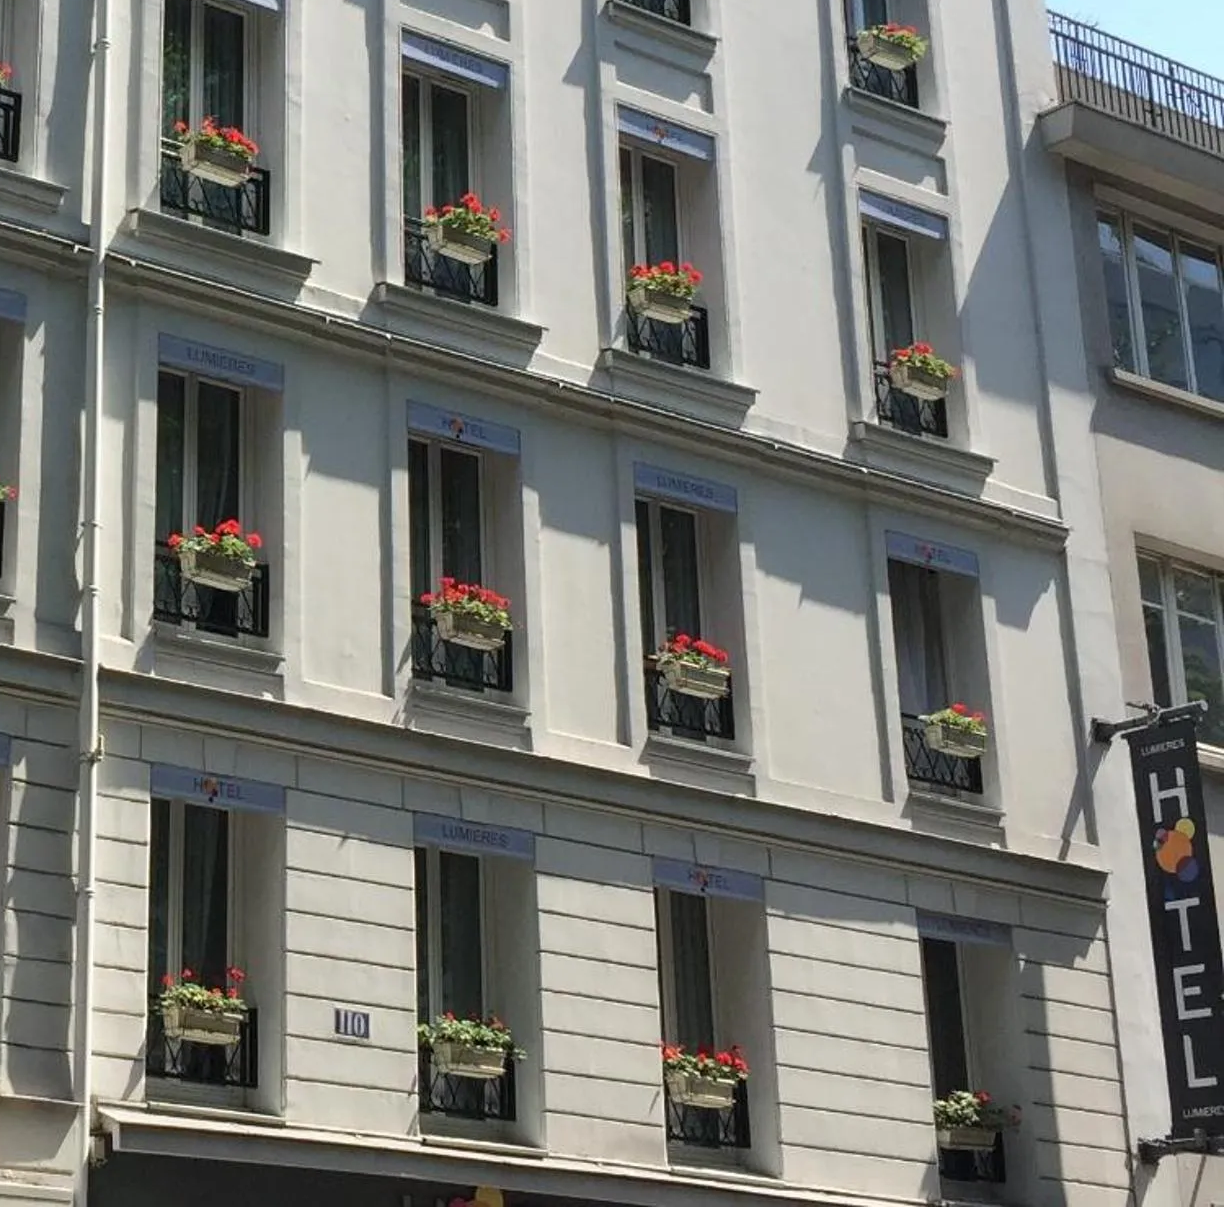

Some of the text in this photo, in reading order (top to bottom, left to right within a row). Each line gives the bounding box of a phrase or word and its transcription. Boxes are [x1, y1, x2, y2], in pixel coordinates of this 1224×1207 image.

[193, 777, 246, 800] HOTEL
[442, 824, 509, 849] LUMIERES
[339, 1010, 365, 1036] 110
